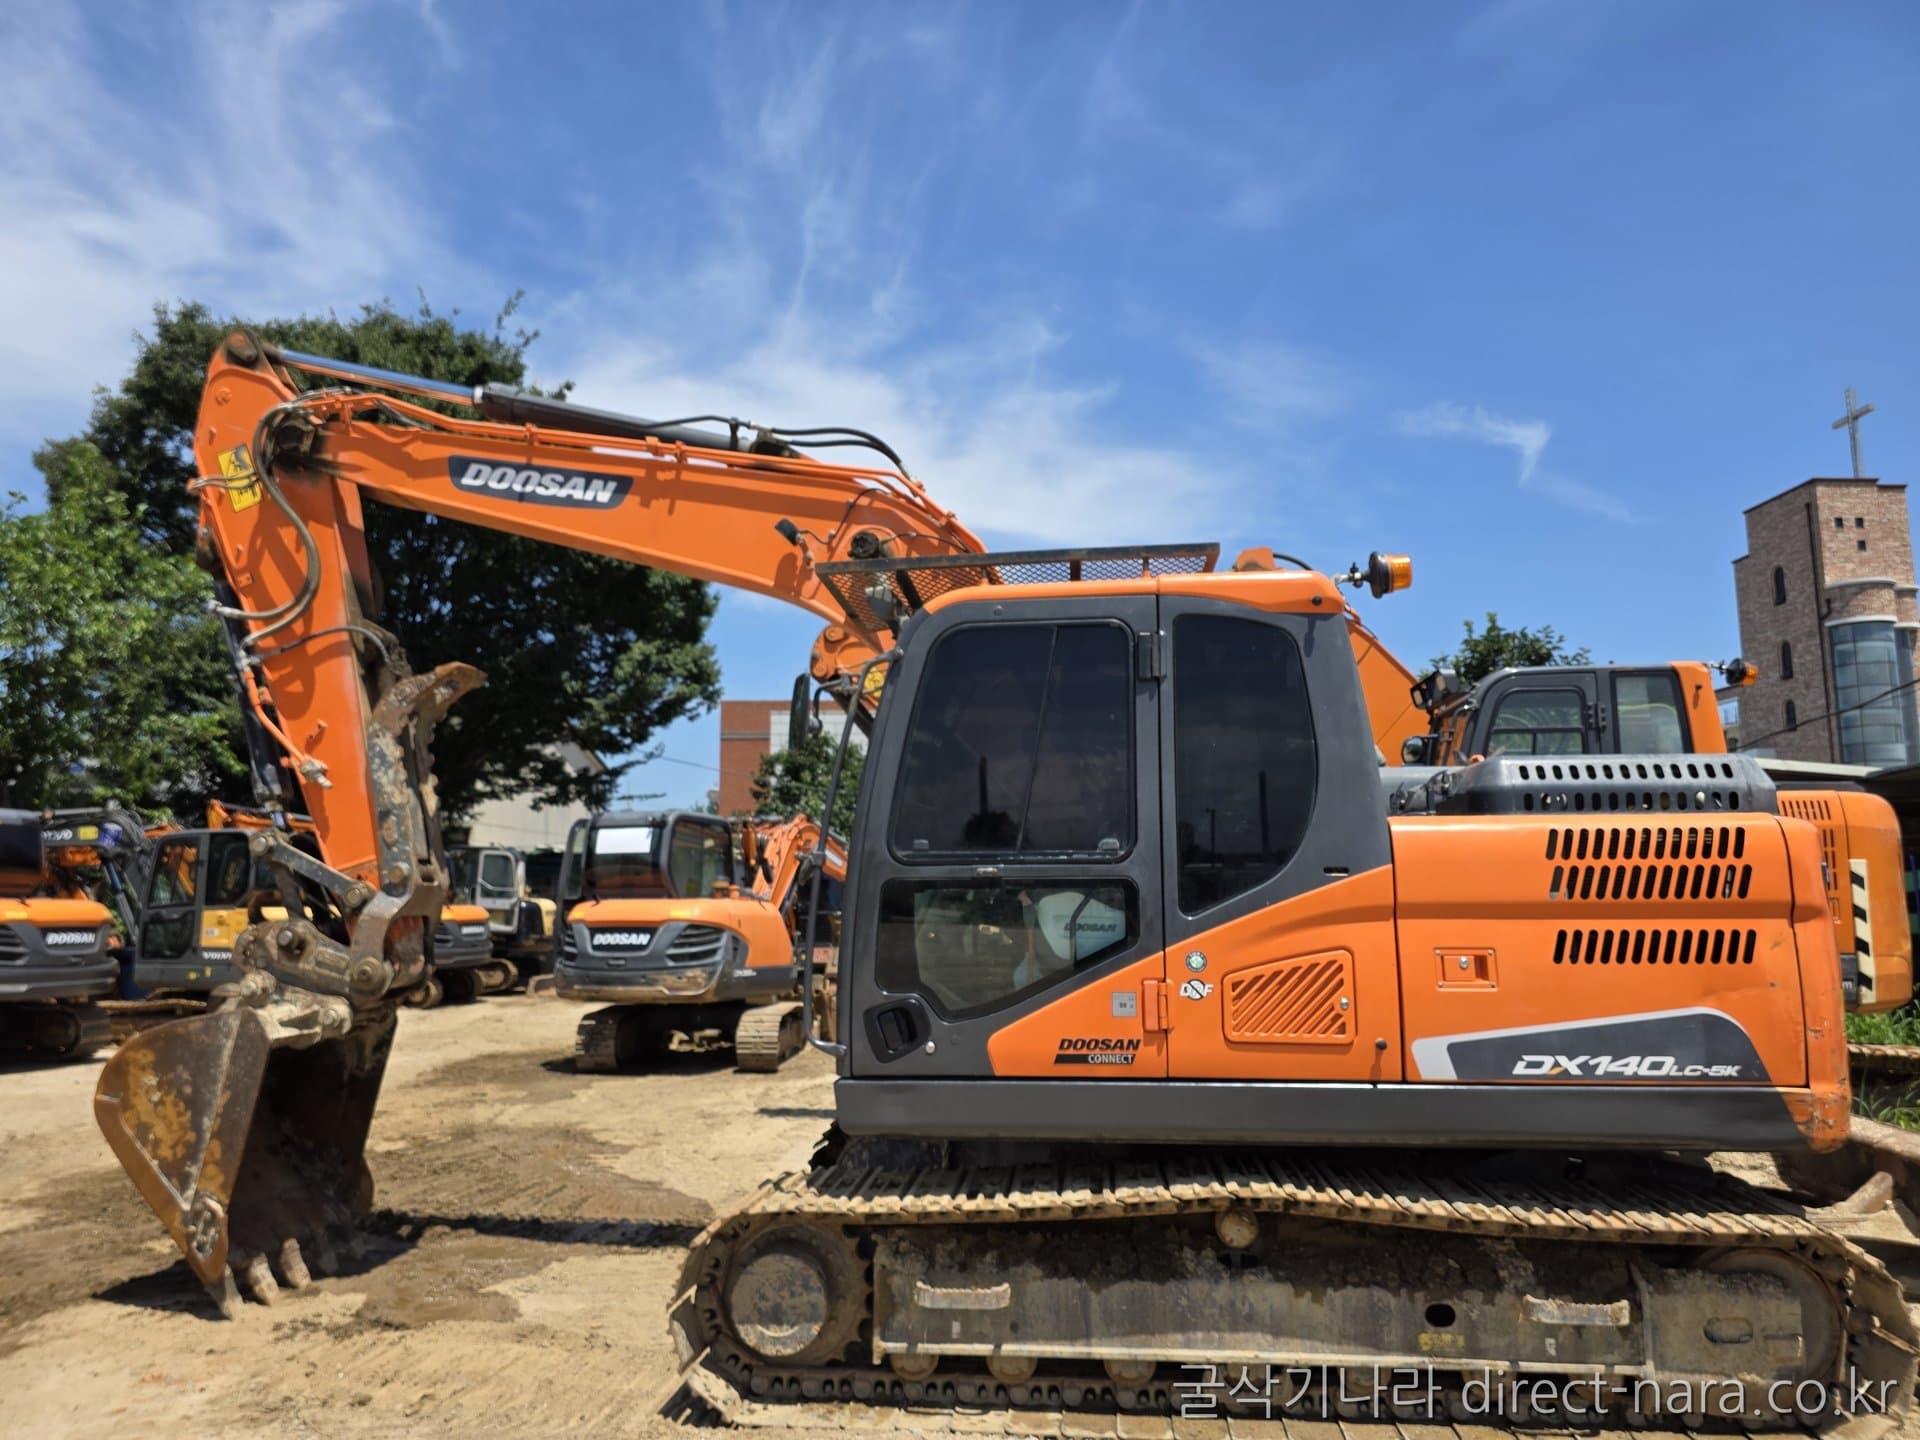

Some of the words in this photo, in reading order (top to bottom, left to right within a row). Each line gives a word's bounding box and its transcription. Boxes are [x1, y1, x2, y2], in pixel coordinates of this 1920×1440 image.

[461, 463, 617, 503] DOOSAN
[46, 932, 96, 944] DOOSAN
[593, 933, 650, 945] DOOSAN
[1058, 1038, 1141, 1051] DOOSAN
[1088, 1054, 1133, 1064] CONNECT
